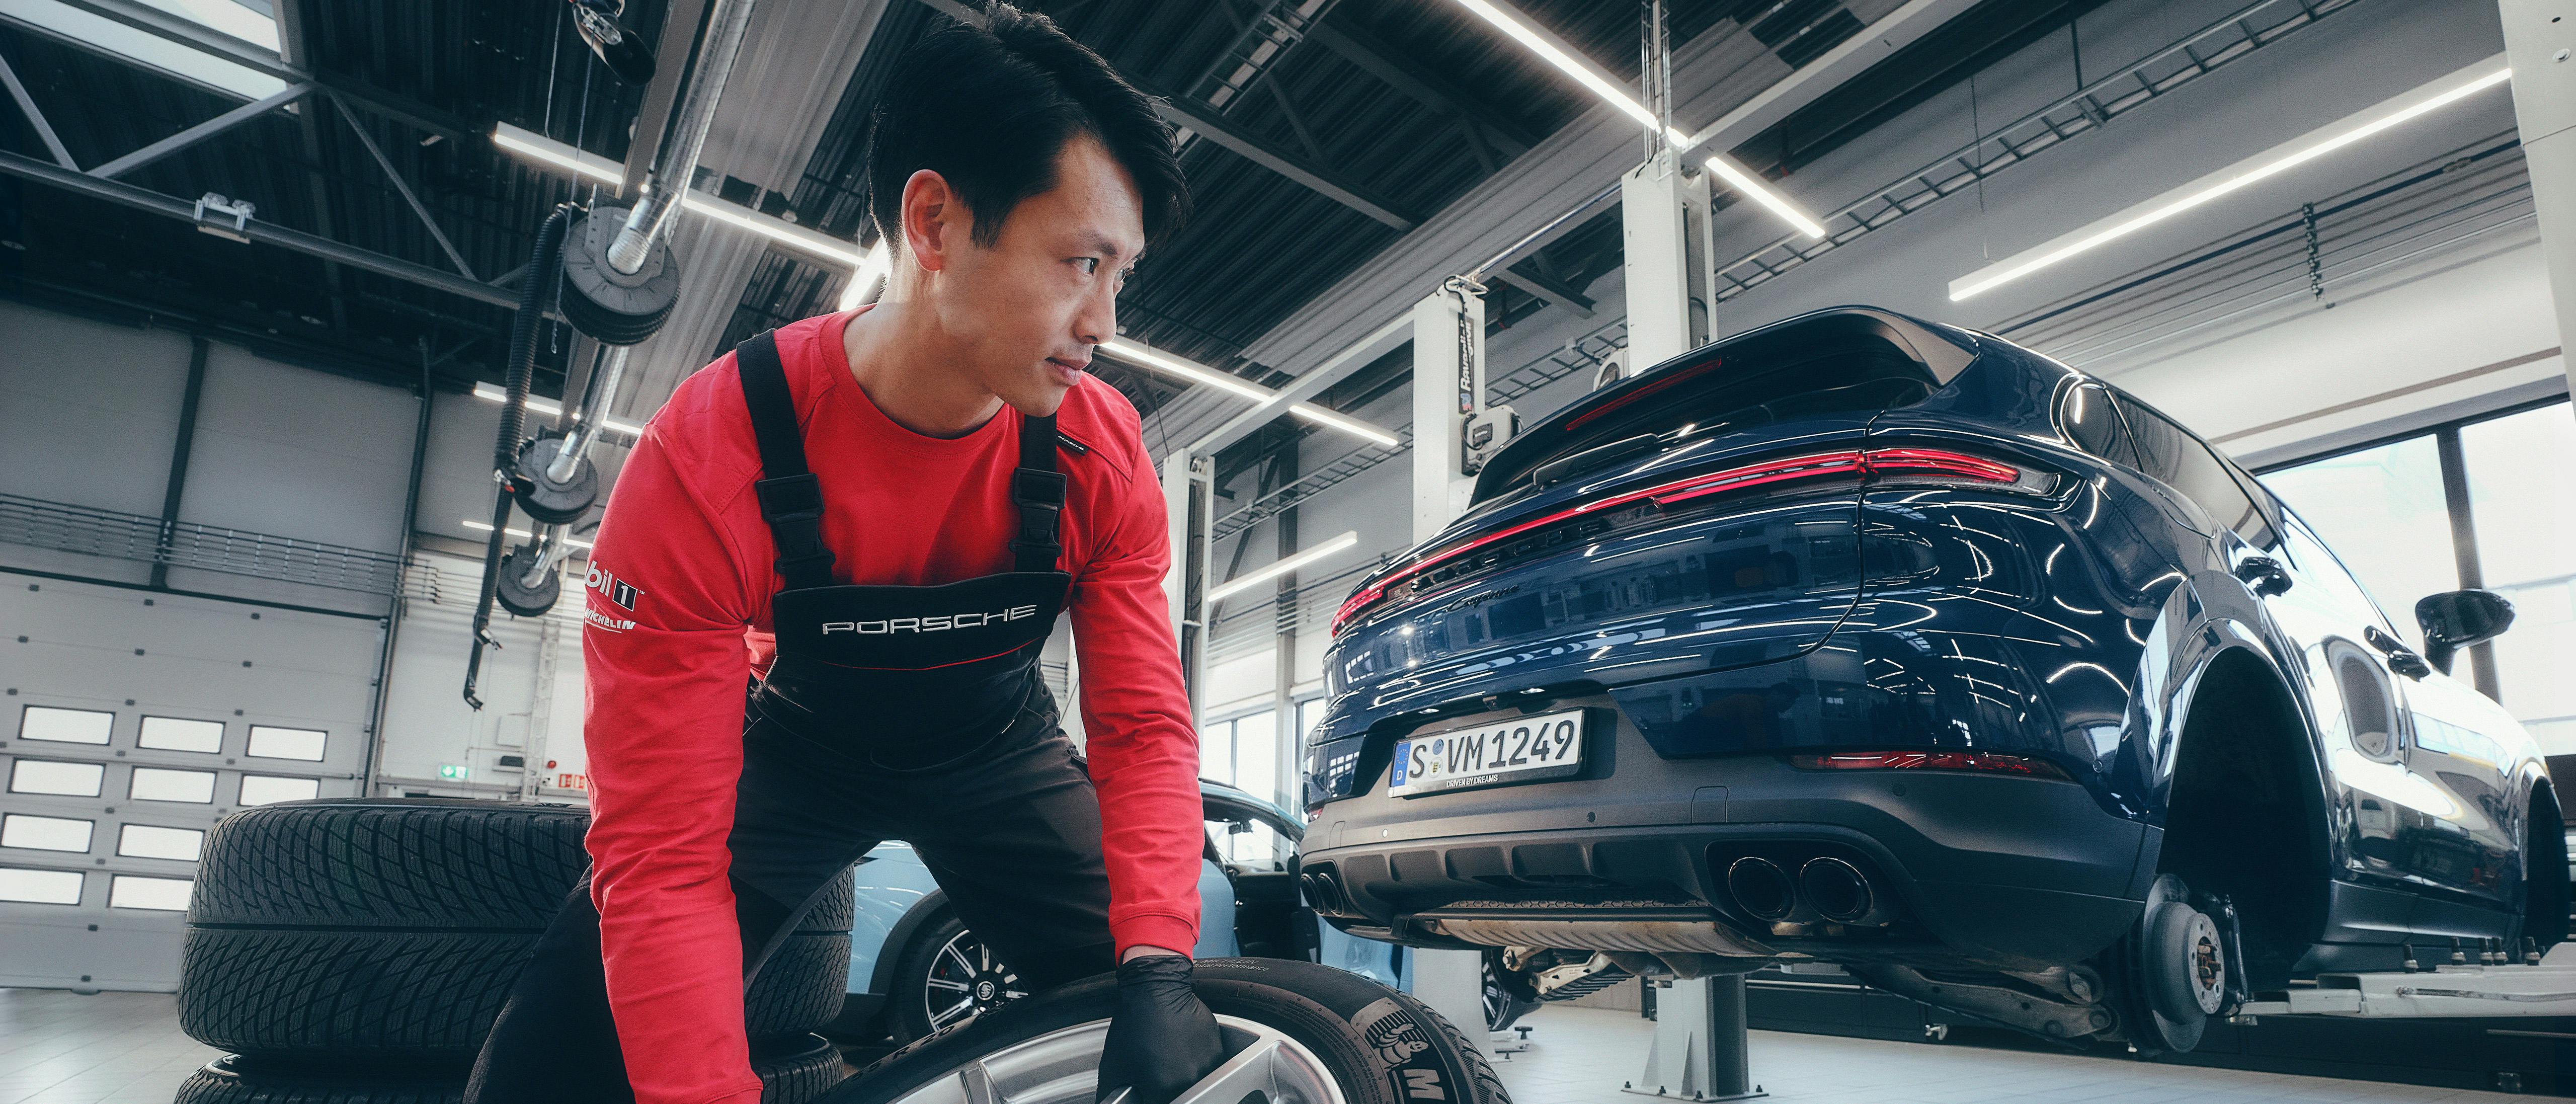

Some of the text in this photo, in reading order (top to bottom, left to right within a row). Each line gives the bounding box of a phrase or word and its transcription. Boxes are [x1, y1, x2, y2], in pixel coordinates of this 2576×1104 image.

[1058, 435, 1084, 451] PORSCHE
[822, 605, 1037, 635] PORSCHE
[1409, 720, 1575, 778] S VM 1249
[1396, 770, 1403, 781] D
[1446, 773, 1498, 788] DRIVEN BY DREAMS
[1213, 963, 1269, 971] Performance
[920, 1025, 955, 1047] 20
